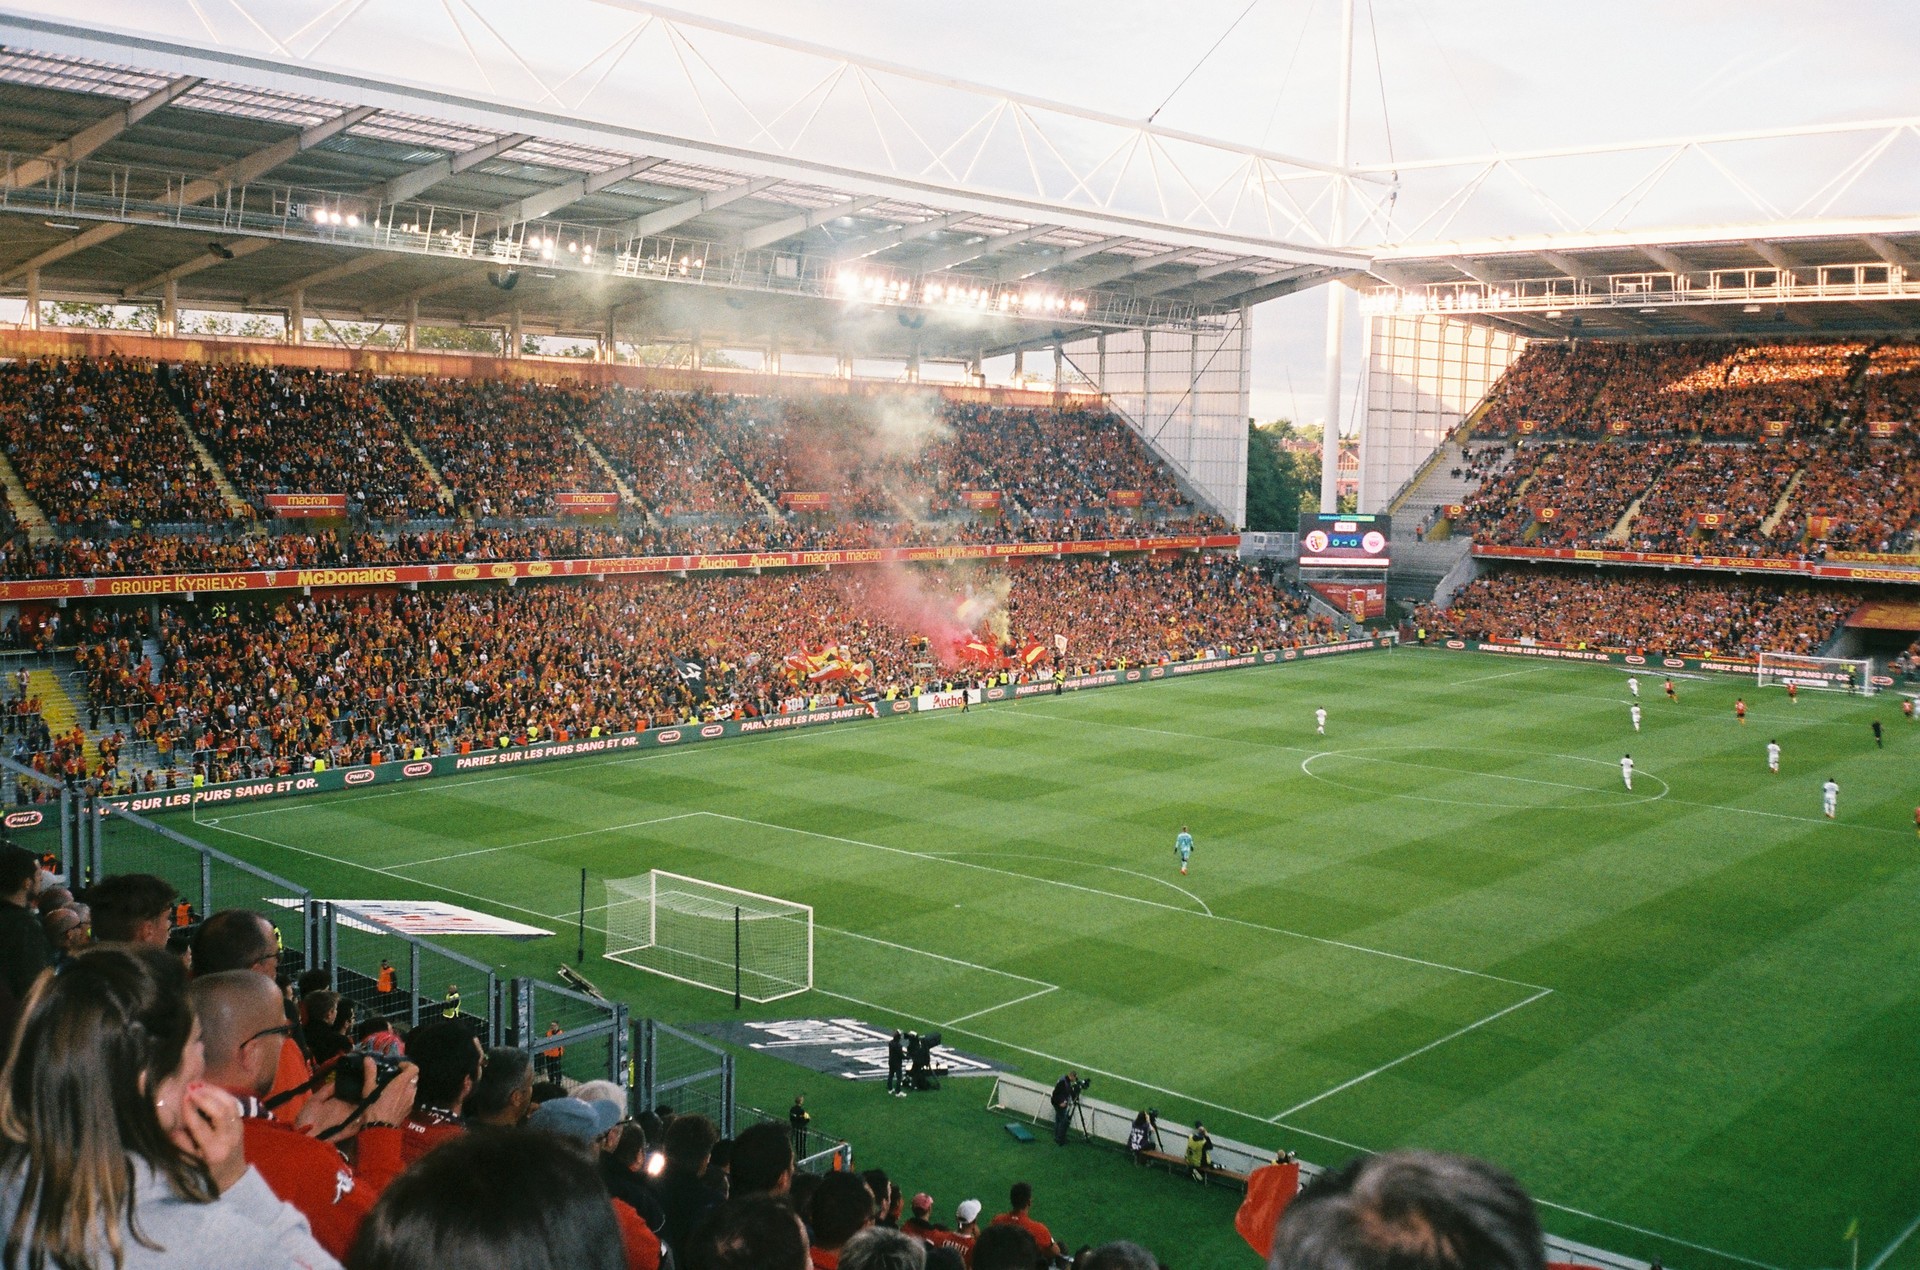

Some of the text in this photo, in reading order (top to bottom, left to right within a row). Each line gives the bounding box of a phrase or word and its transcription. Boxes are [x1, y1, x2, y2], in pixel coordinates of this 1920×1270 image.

[0, 336, 87, 357] uchan
[287, 496, 329, 506] macron
[572, 494, 604, 503] macron
[698, 556, 738, 569] Auchan
[749, 554, 787, 567] Auchan
[803, 552, 840, 563] macron
[846, 551, 882, 561] macron
[297, 568, 397, 586] McDonald's
[1866, 571, 1920, 581] boulang
[111, 576, 248, 594] GROUPE KYRIELYS
[1700, 662, 1731, 671] PARIEZ
[1732, 665, 1751, 673] SUR
[1016, 683, 1052, 694] PARIEZ SUR
[933, 694, 963, 708] Aucha
[773, 717, 790, 726] SUR
[792, 715, 807, 724] LES
[808, 712, 829, 722] PURS
[831, 709, 853, 720] SANG
[854, 708, 864, 716] ET
[456, 736, 639, 769] PARIEZ SUR LES PURS SANG ET OR.
[131, 797, 162, 811] SUR
[165, 793, 191, 806] LES
[195, 788, 232, 803] PURS
[235, 783, 274, 798] SANG
[276, 780, 291, 792] ET
[296, 778, 319, 790] OR.
